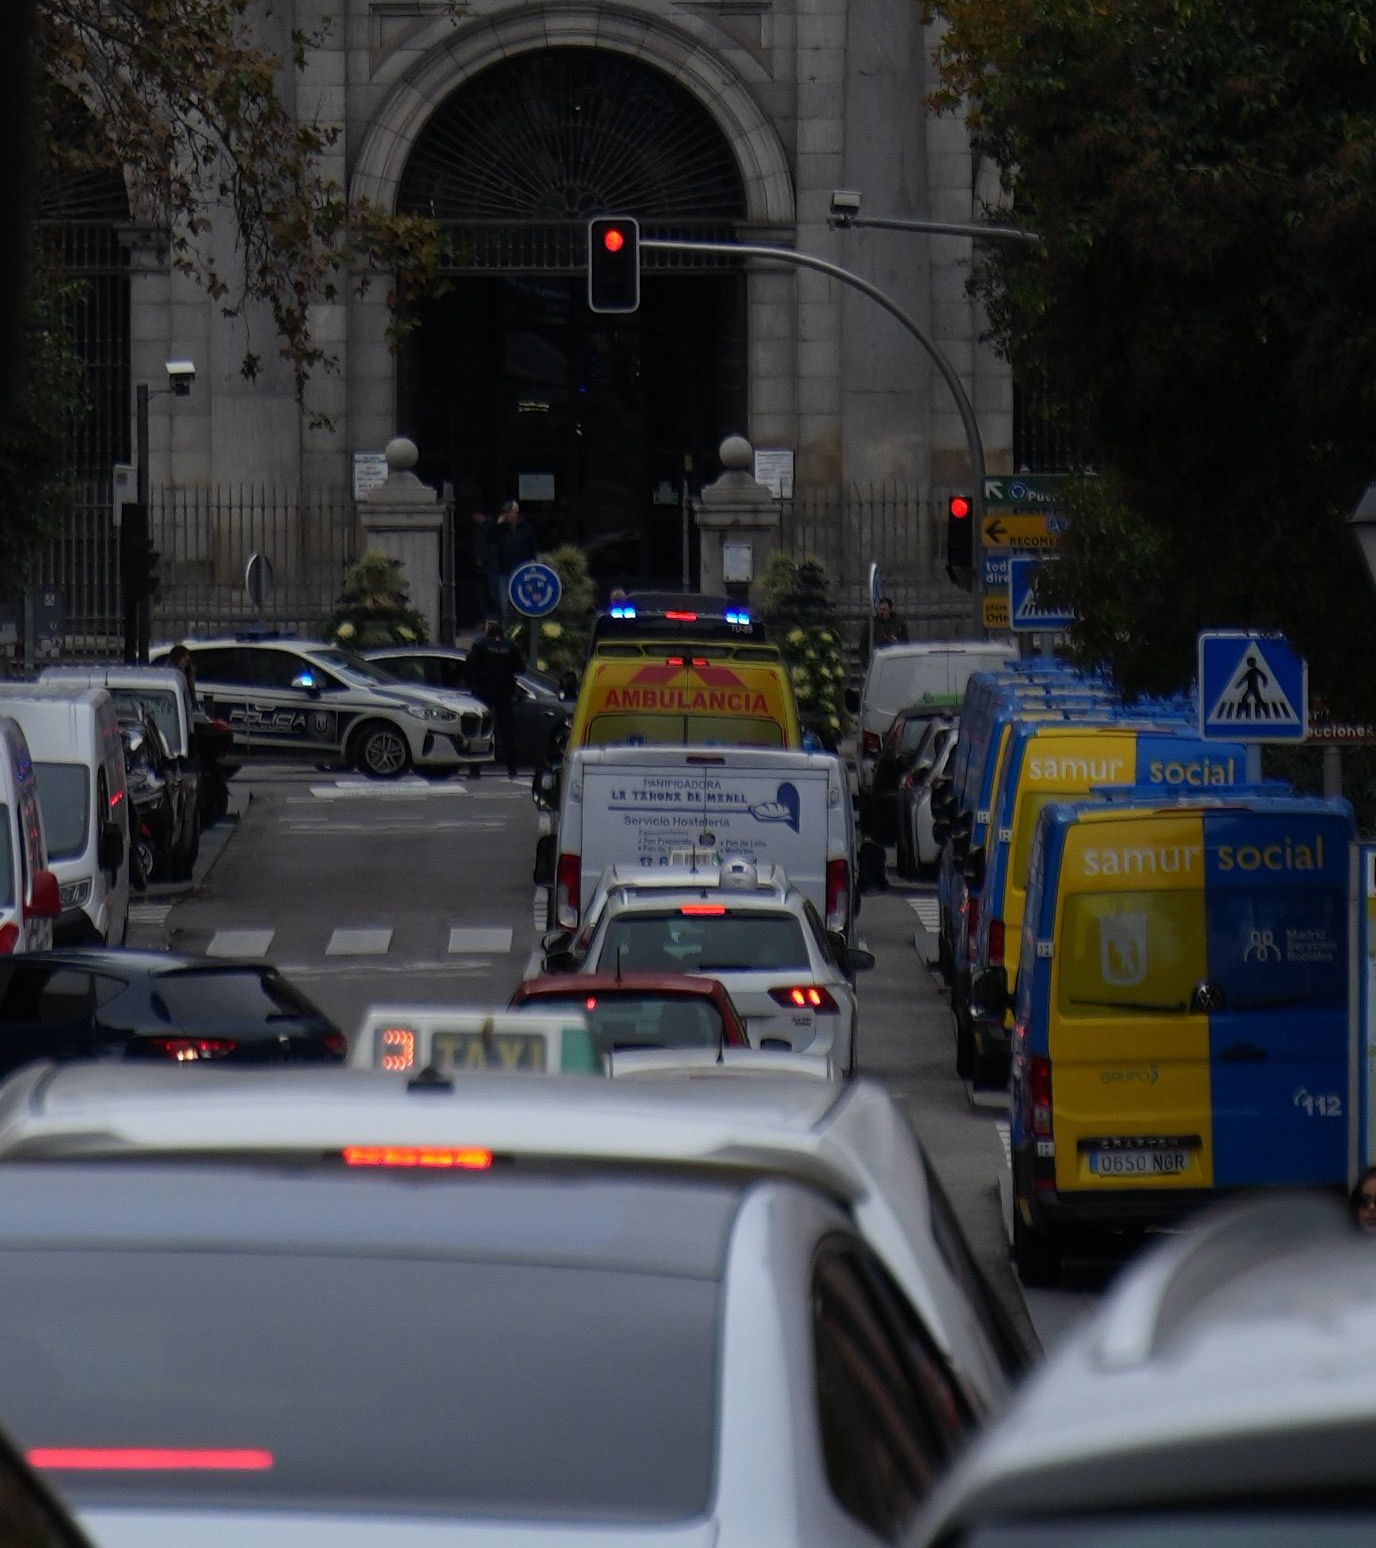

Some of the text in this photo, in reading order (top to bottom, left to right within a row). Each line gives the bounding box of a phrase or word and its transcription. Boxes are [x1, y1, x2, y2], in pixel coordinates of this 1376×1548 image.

[605, 689, 768, 713] AMBULANCIA
[1028, 755, 1235, 786] samur social
[1083, 833, 1325, 876] samur social
[1303, 1094, 1343, 1117] 112
[1102, 1154, 1185, 1173] 0650 NGR
